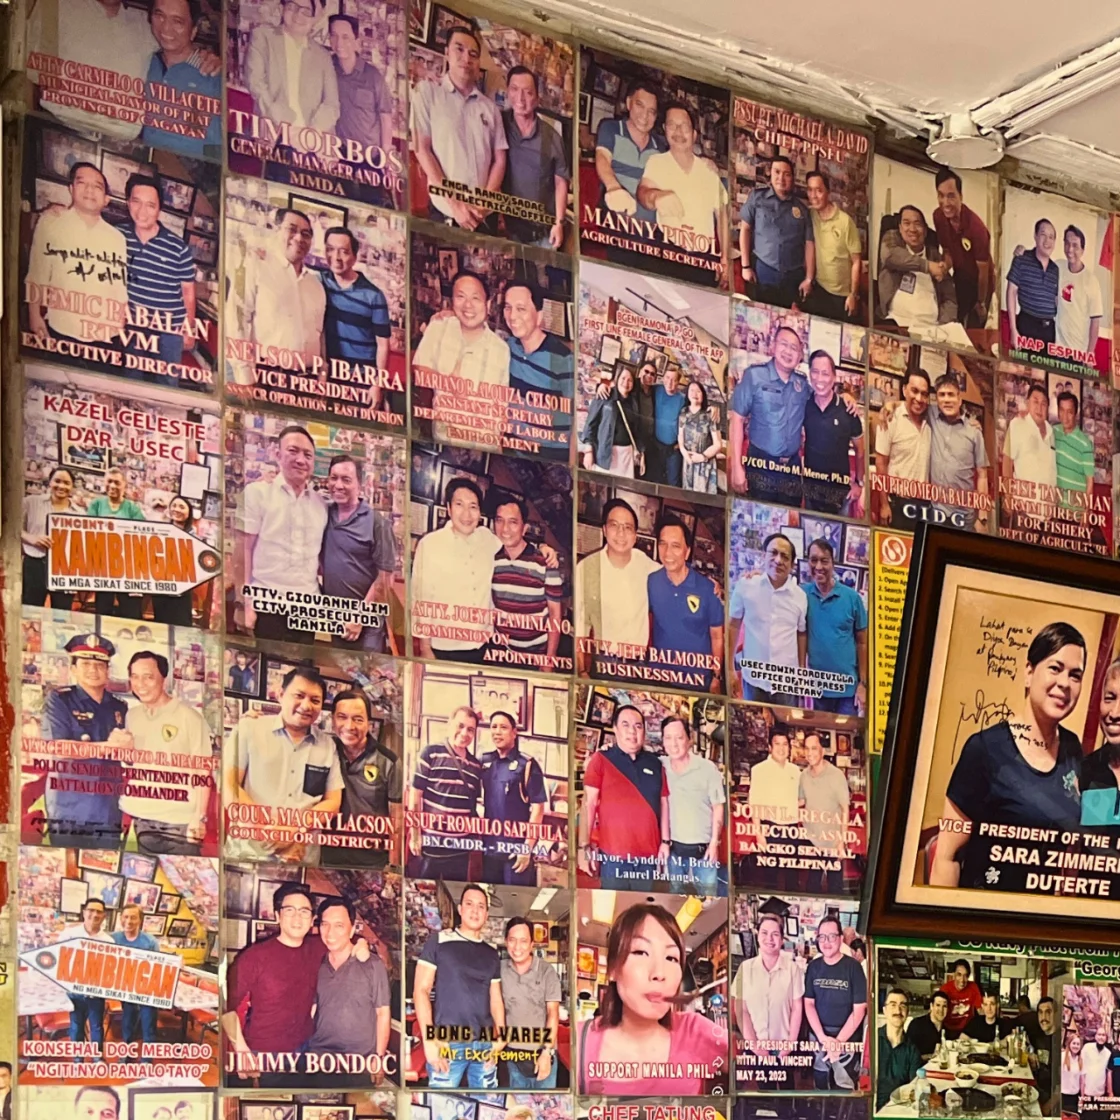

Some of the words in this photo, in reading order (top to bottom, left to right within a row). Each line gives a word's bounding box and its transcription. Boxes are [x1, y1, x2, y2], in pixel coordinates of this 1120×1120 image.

[228, 109, 291, 146] TIM
[300, 127, 403, 174] ORBOS
[231, 137, 291, 164] GENERAL
[293, 154, 353, 180] MANAGER
[356, 171, 380, 186] AND
[383, 177, 405, 193] OIC
[290, 171, 345, 196] MMDA
[583, 204, 659, 241] MANNY
[662, 224, 722, 258] PIÑOL
[581, 230, 661, 258] AGRICULTURE
[663, 249, 727, 273] SECRETARY
[25, 282, 102, 320] DEMIC
[107, 301, 210, 341] PABALAN
[22, 332, 122, 366] EXECUTIVE
[125, 353, 214, 384] DIRECTOR
[1016, 335, 1045, 351] NAP
[1048, 342, 1097, 367] ESPINA
[1030, 354, 1100, 378] CONSTRUCTION
[252, 369, 287, 391] VICE
[290, 375, 371, 404] PRESIDENT
[44, 395, 113, 422] KAZEL
[119, 410, 206, 441] CELESTE
[270, 389, 327, 413] OPERATION
[334, 403, 359, 418] EAST
[360, 406, 405, 425] DIVISION
[67, 418, 111, 448] DAR
[131, 438, 183, 462] USEC
[1017, 515, 1041, 530] FOR
[1044, 521, 1093, 539] FISHERY
[51, 529, 197, 583] KAMBINGAN
[51, 577, 66, 587] NG
[69, 578, 91, 589] MGA
[94, 580, 121, 590] SIKAT
[124, 582, 151, 591] SINCE
[155, 583, 177, 592] 1980
[252, 600, 288, 615] CITY
[290, 606, 380, 627] PROSECUTOR
[286, 590, 358, 612] GIOVANNE
[361, 601, 389, 616] LIM
[288, 616, 346, 635] MANILA
[596, 661, 706, 687] BUSINESSMAN
[227, 803, 275, 826] COUN.
[277, 807, 334, 830] MACKY
[336, 813, 396, 836] LACSON
[229, 826, 315, 845] COUNCILOR
[938, 818, 972, 835] VICE
[979, 823, 1059, 844] PRESIDENT
[1061, 831, 1080, 846] OF
[1083, 833, 1110, 850] THE
[740, 841, 795, 855] BANGKO
[798, 844, 856, 860] SENTRAL
[756, 855, 776, 868] NG
[778, 857, 842, 872] PILIPINAS
[989, 844, 1041, 866] SARA
[615, 867, 650, 880] Laurel
[652, 870, 700, 884] Batangas
[1025, 872, 1111, 897] DUTERTE
[426, 1025, 472, 1042] BONG
[479, 1025, 552, 1043] ALVAREZ
[23, 1040, 102, 1058] KONSEHAL
[106, 1041, 139, 1058] DOC
[141, 1042, 212, 1058] MERCADO
[224, 1051, 301, 1074] JIMMY
[304, 1051, 397, 1076] BONDOC
[588, 1062, 638, 1078] SUPPORT
[642, 1062, 683, 1079] MANILA
[687, 1064, 715, 1079] PHIL.
[736, 1070, 753, 1082] MAY
[769, 1070, 787, 1082] 2023
